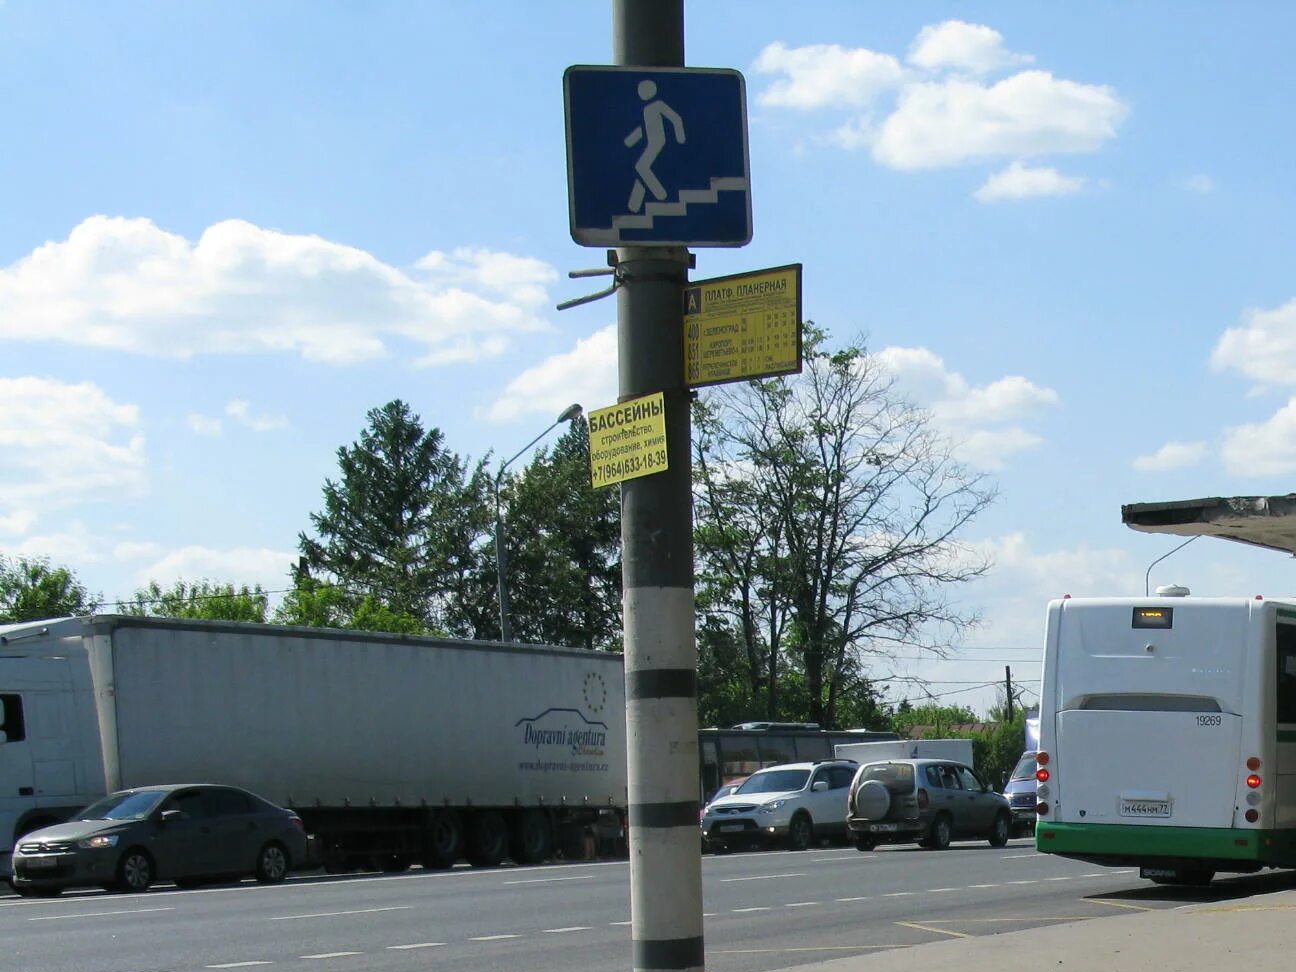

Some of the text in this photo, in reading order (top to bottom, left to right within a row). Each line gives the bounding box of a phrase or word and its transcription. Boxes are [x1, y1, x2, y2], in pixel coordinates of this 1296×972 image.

[736, 279, 787, 296] ПЛАНЕРНАЯ
[688, 294, 697, 311] А
[589, 398, 663, 433] БАССЕЙНЫ
[600, 424, 654, 446] строительство,
[591, 441, 642, 462] оборудование,
[592, 449, 666, 482] +7(964)633-18-39
[1196, 715, 1222, 726] 19269
[524, 722, 567, 749] Dopravní
[567, 727, 606, 756] agentura
